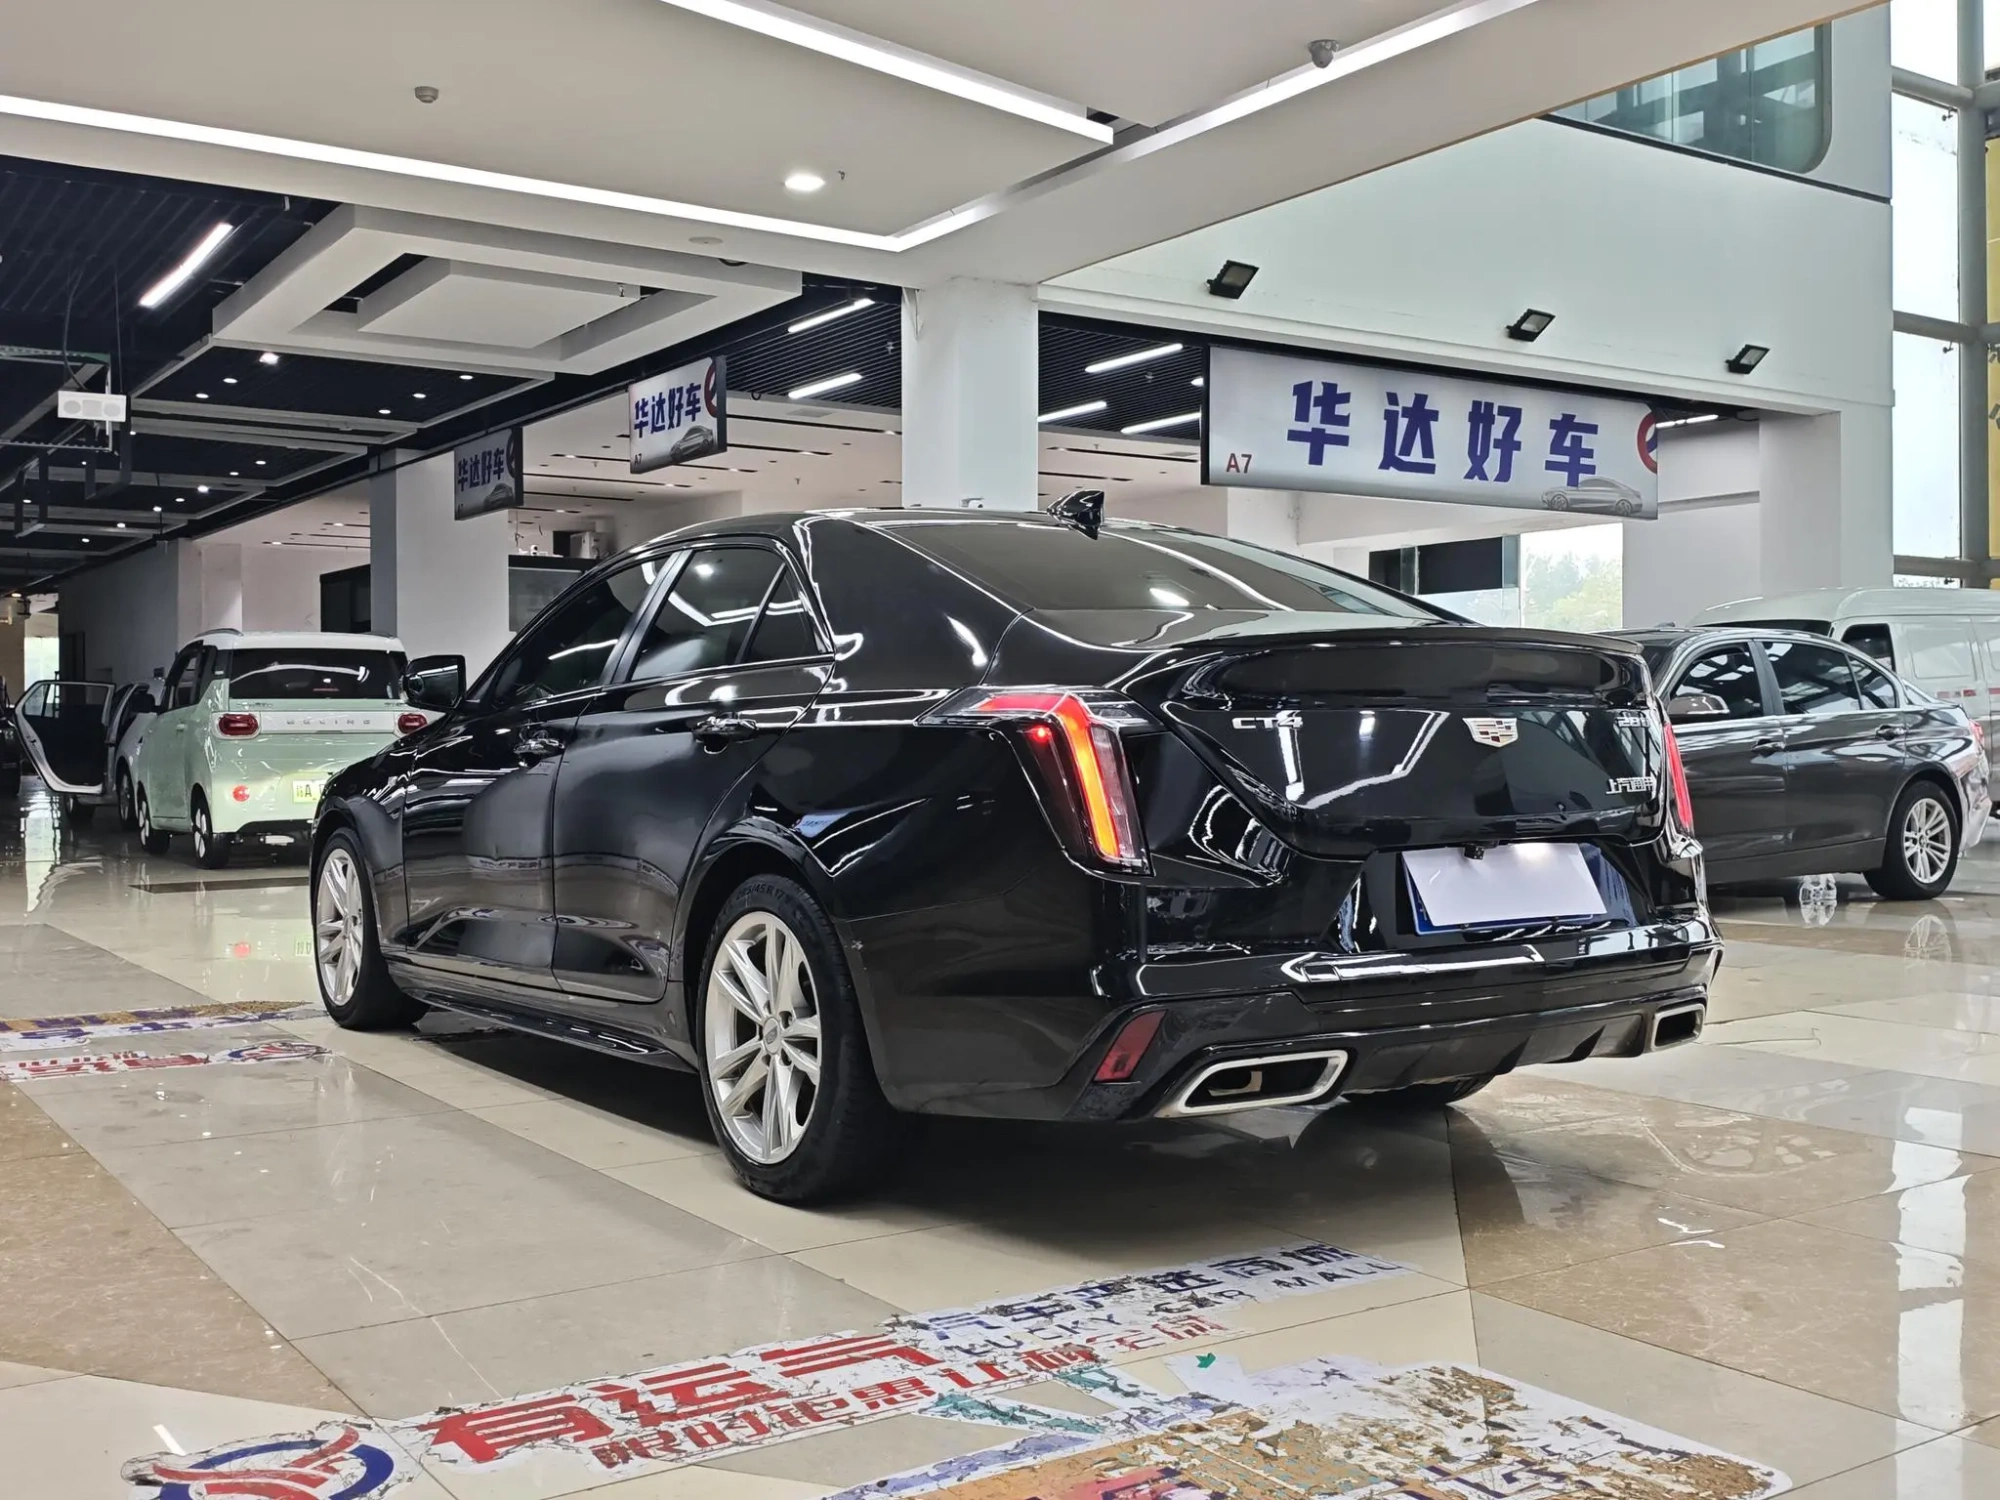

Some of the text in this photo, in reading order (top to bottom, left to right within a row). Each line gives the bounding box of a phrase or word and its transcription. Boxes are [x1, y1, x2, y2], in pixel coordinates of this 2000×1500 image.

[634, 382, 702, 439] 华达好车
[1286, 380, 1599, 487] 华达好车
[458, 447, 504, 492] 华达好车
[634, 453, 642, 466] A7
[1226, 452, 1253, 474] A7
[1232, 716, 1303, 729] CT4
[956, 1263, 1402, 1356] LUCKY CAR MALL
